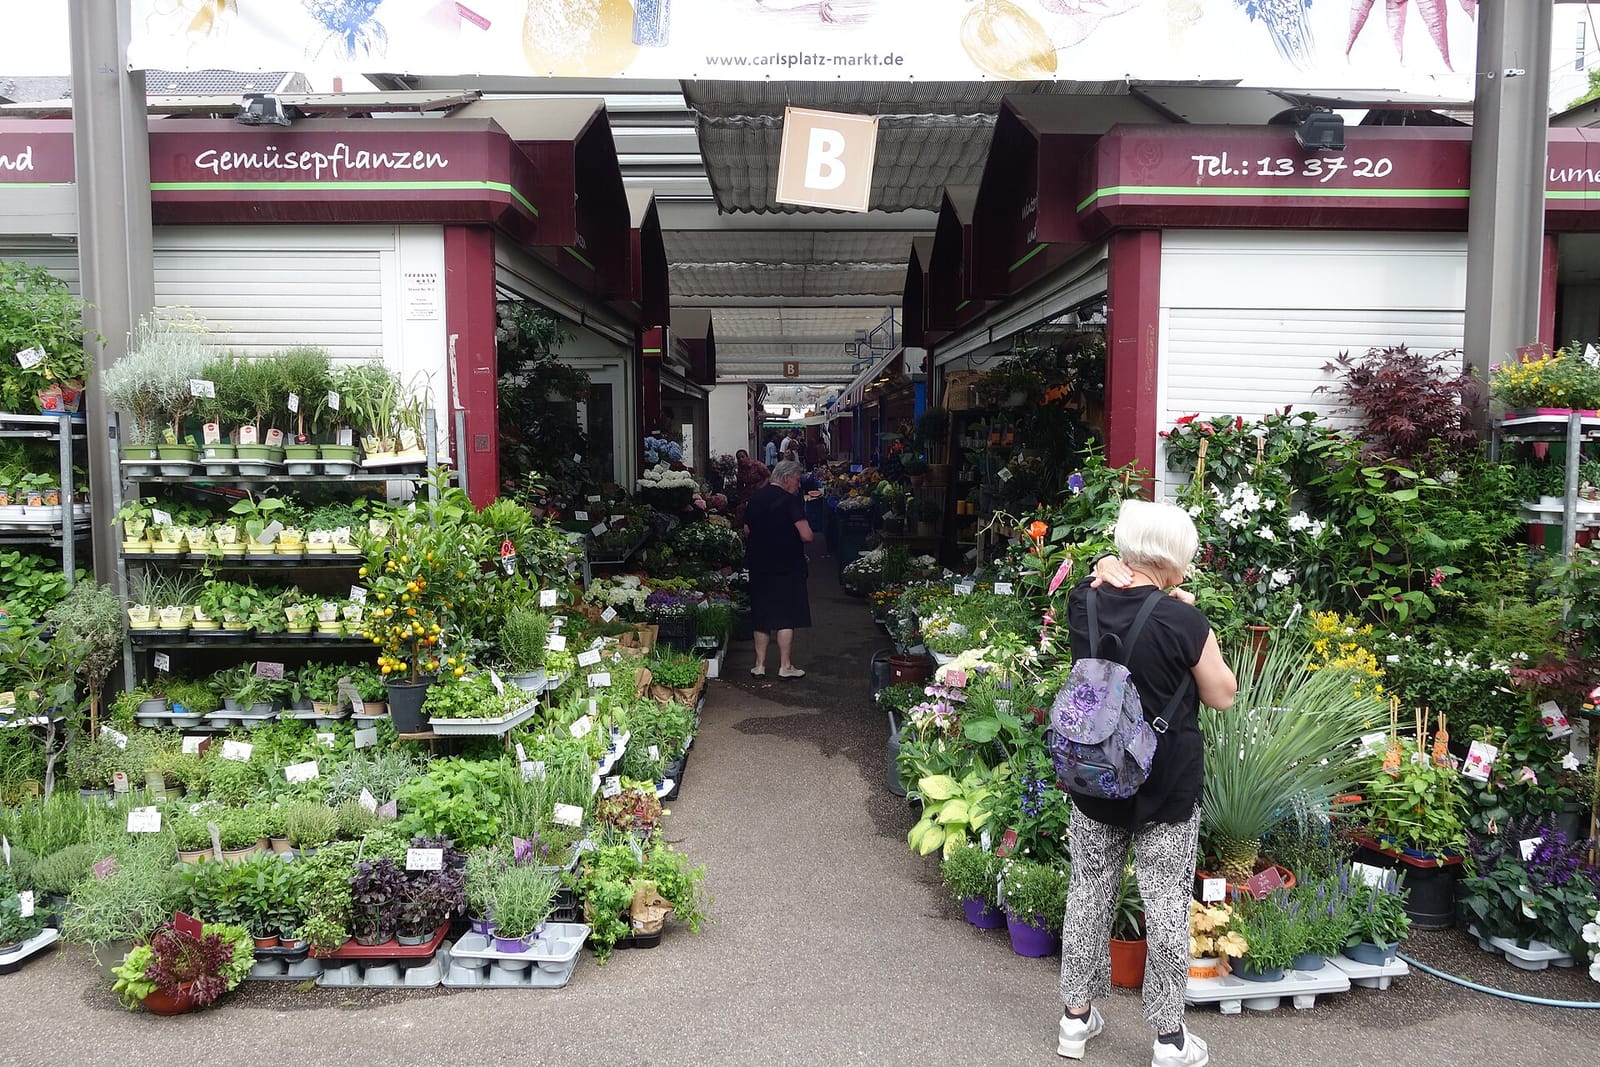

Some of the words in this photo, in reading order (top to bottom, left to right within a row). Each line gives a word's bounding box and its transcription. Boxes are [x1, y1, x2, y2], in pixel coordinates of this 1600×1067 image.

[706, 51, 904, 69] www.carlsplatz-markt.de
[194, 142, 449, 180] Gemüsepflanzen
[804, 127, 846, 190] B
[1191, 152, 1249, 177] Tel.:
[1256, 157, 1295, 177] 13
[1302, 156, 1348, 183] 37
[1352, 157, 1393, 178] 20
[787, 363, 796, 375] B
